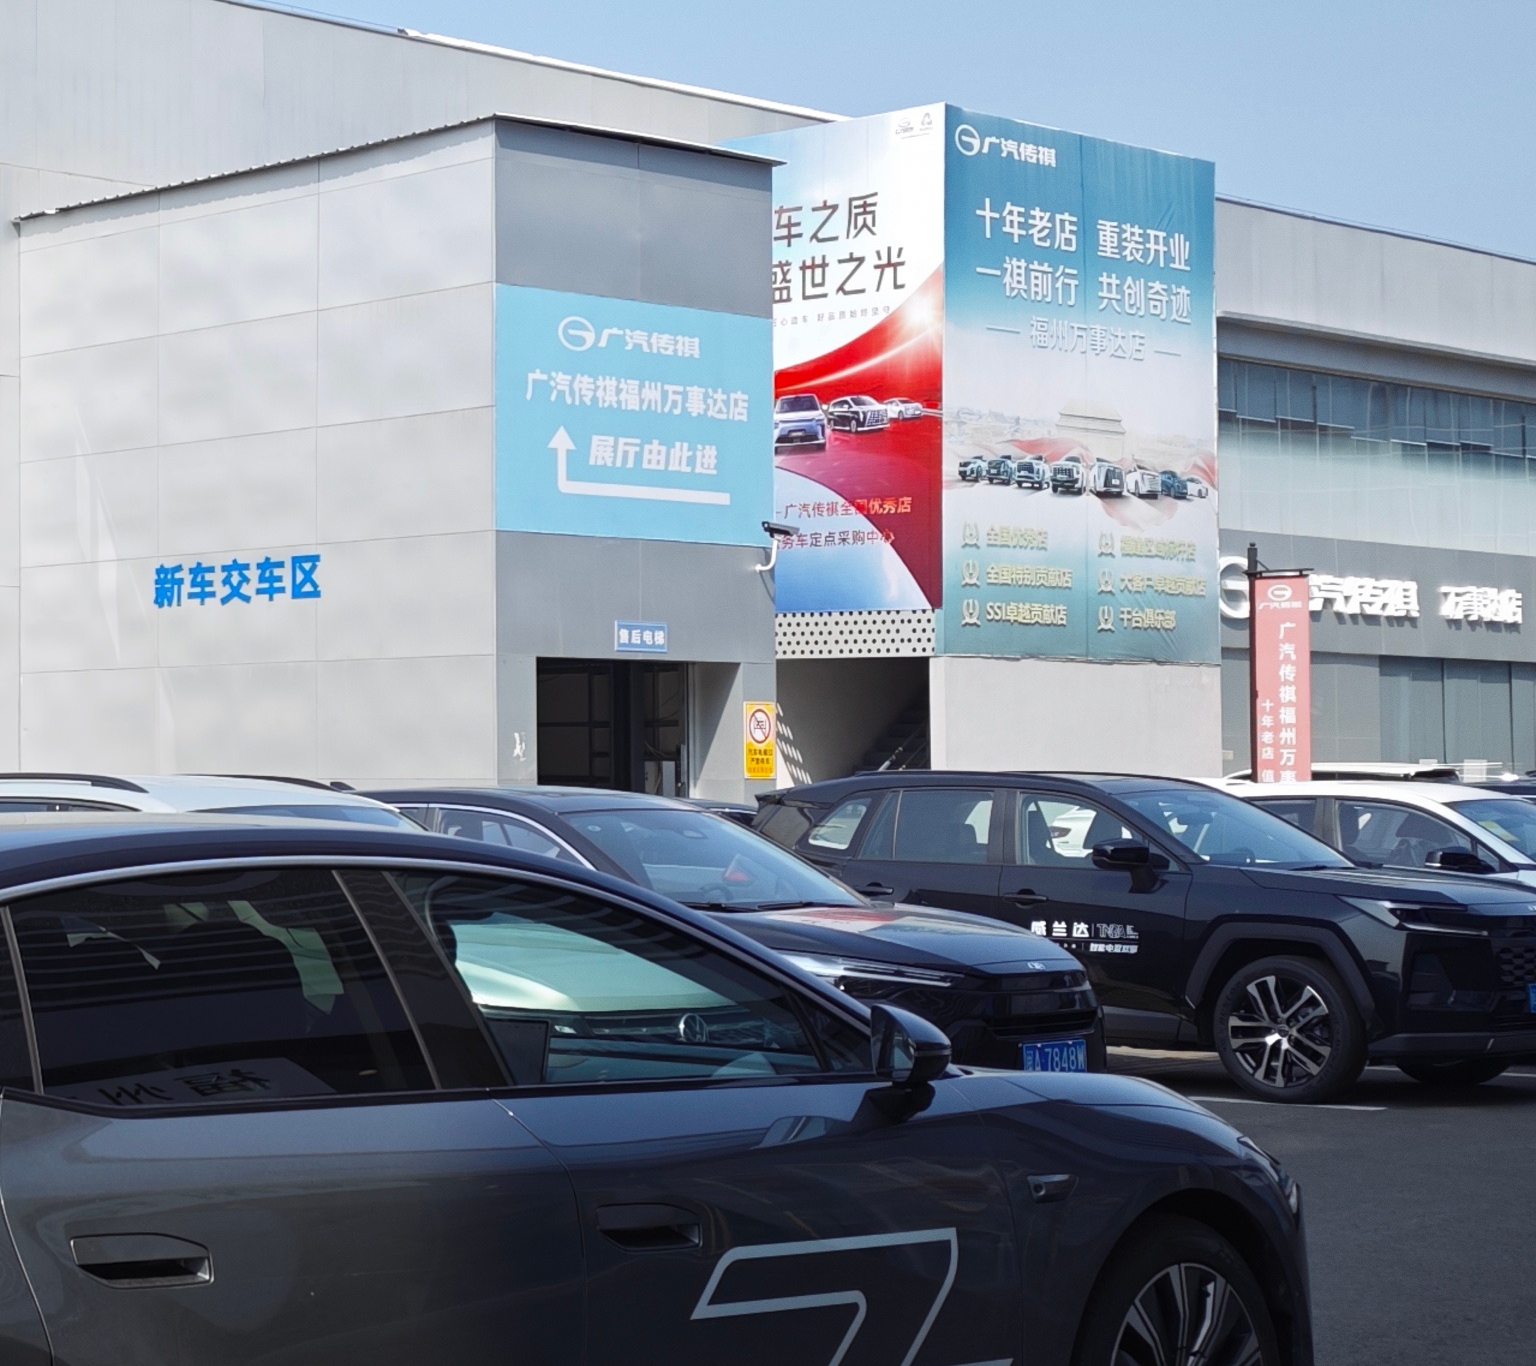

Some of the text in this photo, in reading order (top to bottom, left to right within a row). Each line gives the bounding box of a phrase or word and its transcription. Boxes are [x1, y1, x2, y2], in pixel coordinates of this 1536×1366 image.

[982, 137, 1057, 167] 广汽传祺
[773, 192, 878, 247] 车之质
[976, 198, 1191, 272] 十年老店 重装开业
[976, 256, 1192, 324] 一祺前行 共创奇迹
[598, 327, 701, 358] 广汽传祺
[1029, 315, 1146, 361] 福州万事达店
[526, 368, 749, 422] 广汽传祺福州万事达店
[589, 435, 718, 475] 展厅由此进
[784, 497, 912, 519] 广汽传祺全国优秀店
[153, 554, 322, 609] 新车交车区
[986, 601, 1068, 626] SSI卓越贡献店
[618, 628, 666, 646] 售后电梯
[1260, 698, 1275, 761] 十年老店
